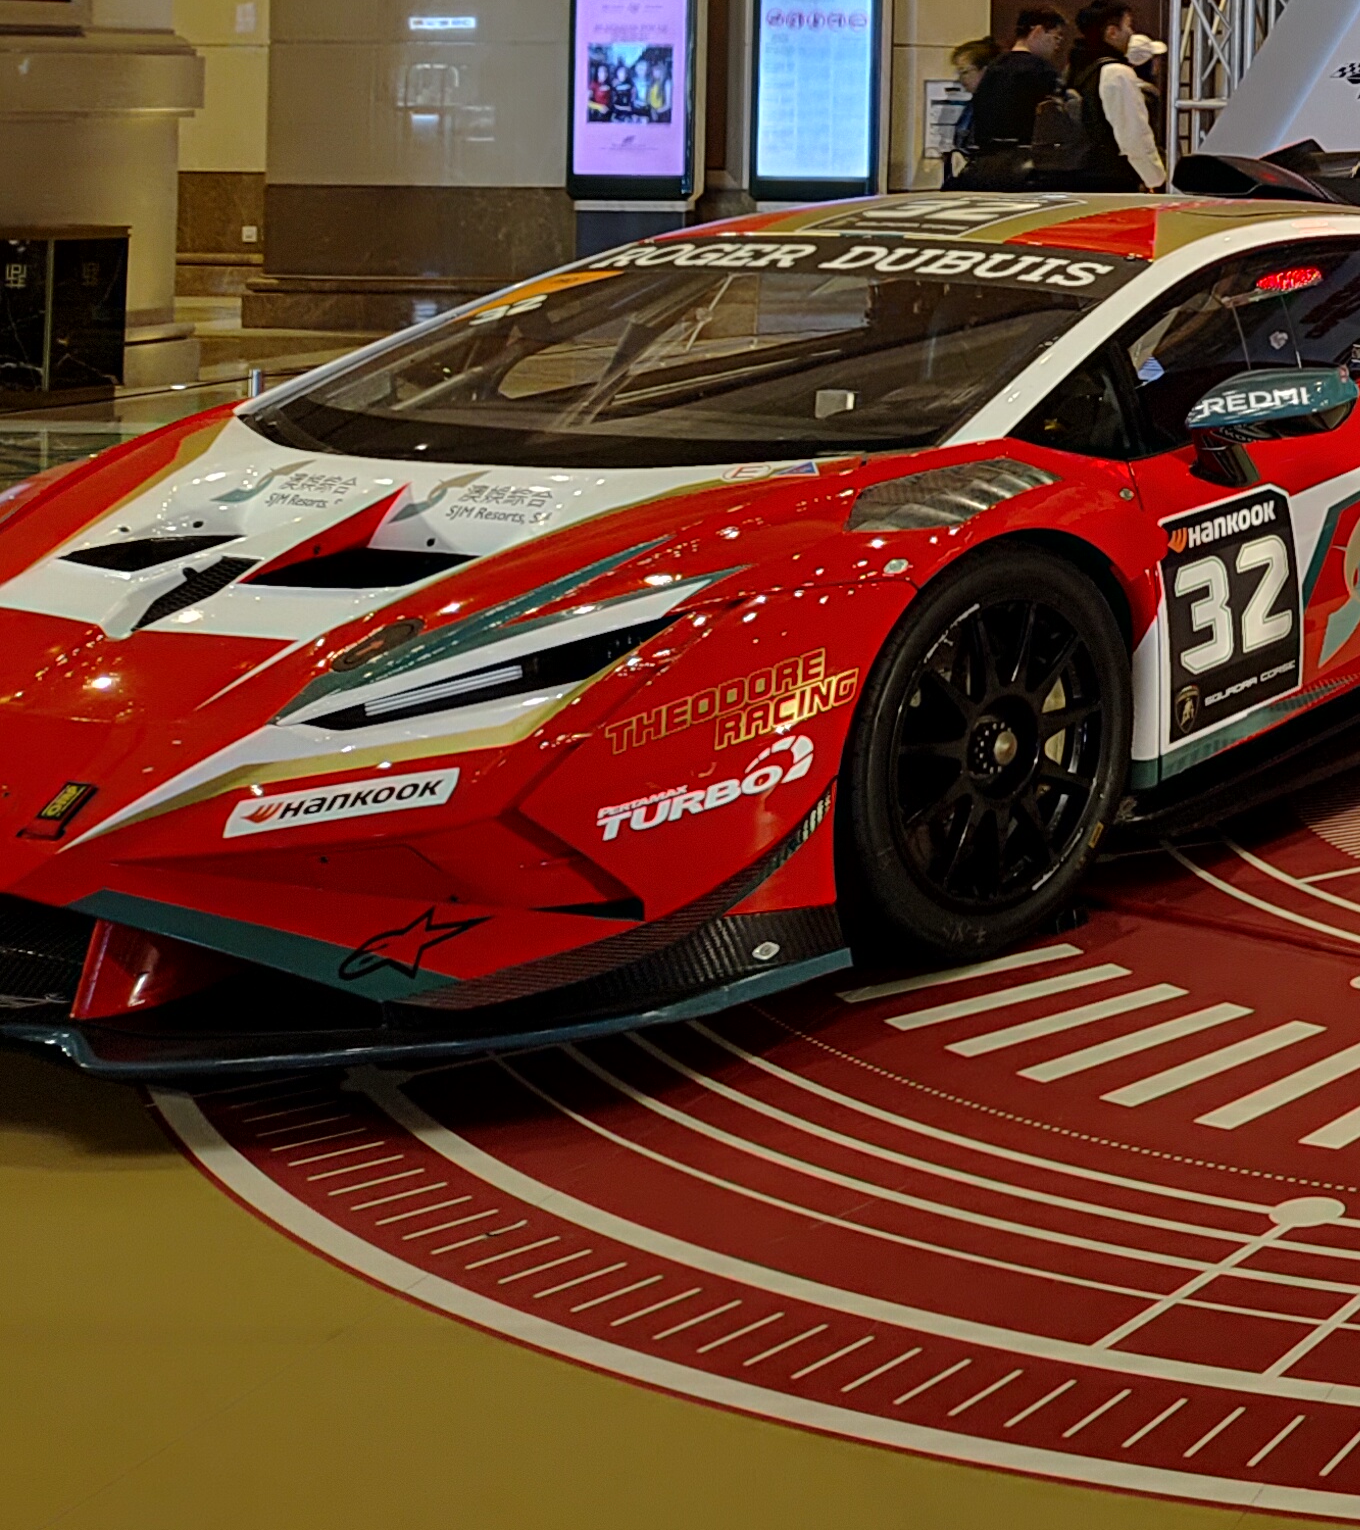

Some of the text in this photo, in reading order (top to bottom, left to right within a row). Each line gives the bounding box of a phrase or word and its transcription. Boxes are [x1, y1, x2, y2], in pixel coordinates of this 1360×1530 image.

[588, 243, 1116, 287] ROGER DUBUIS
[1202, 387, 1310, 416] REDMI
[446, 504, 476, 520] SJM
[1174, 534, 1293, 675] 32
[604, 647, 826, 755] THEODORE
[713, 667, 860, 751] RACING
[596, 764, 784, 842] TURBO
[597, 784, 689, 820] PERTAMAX
